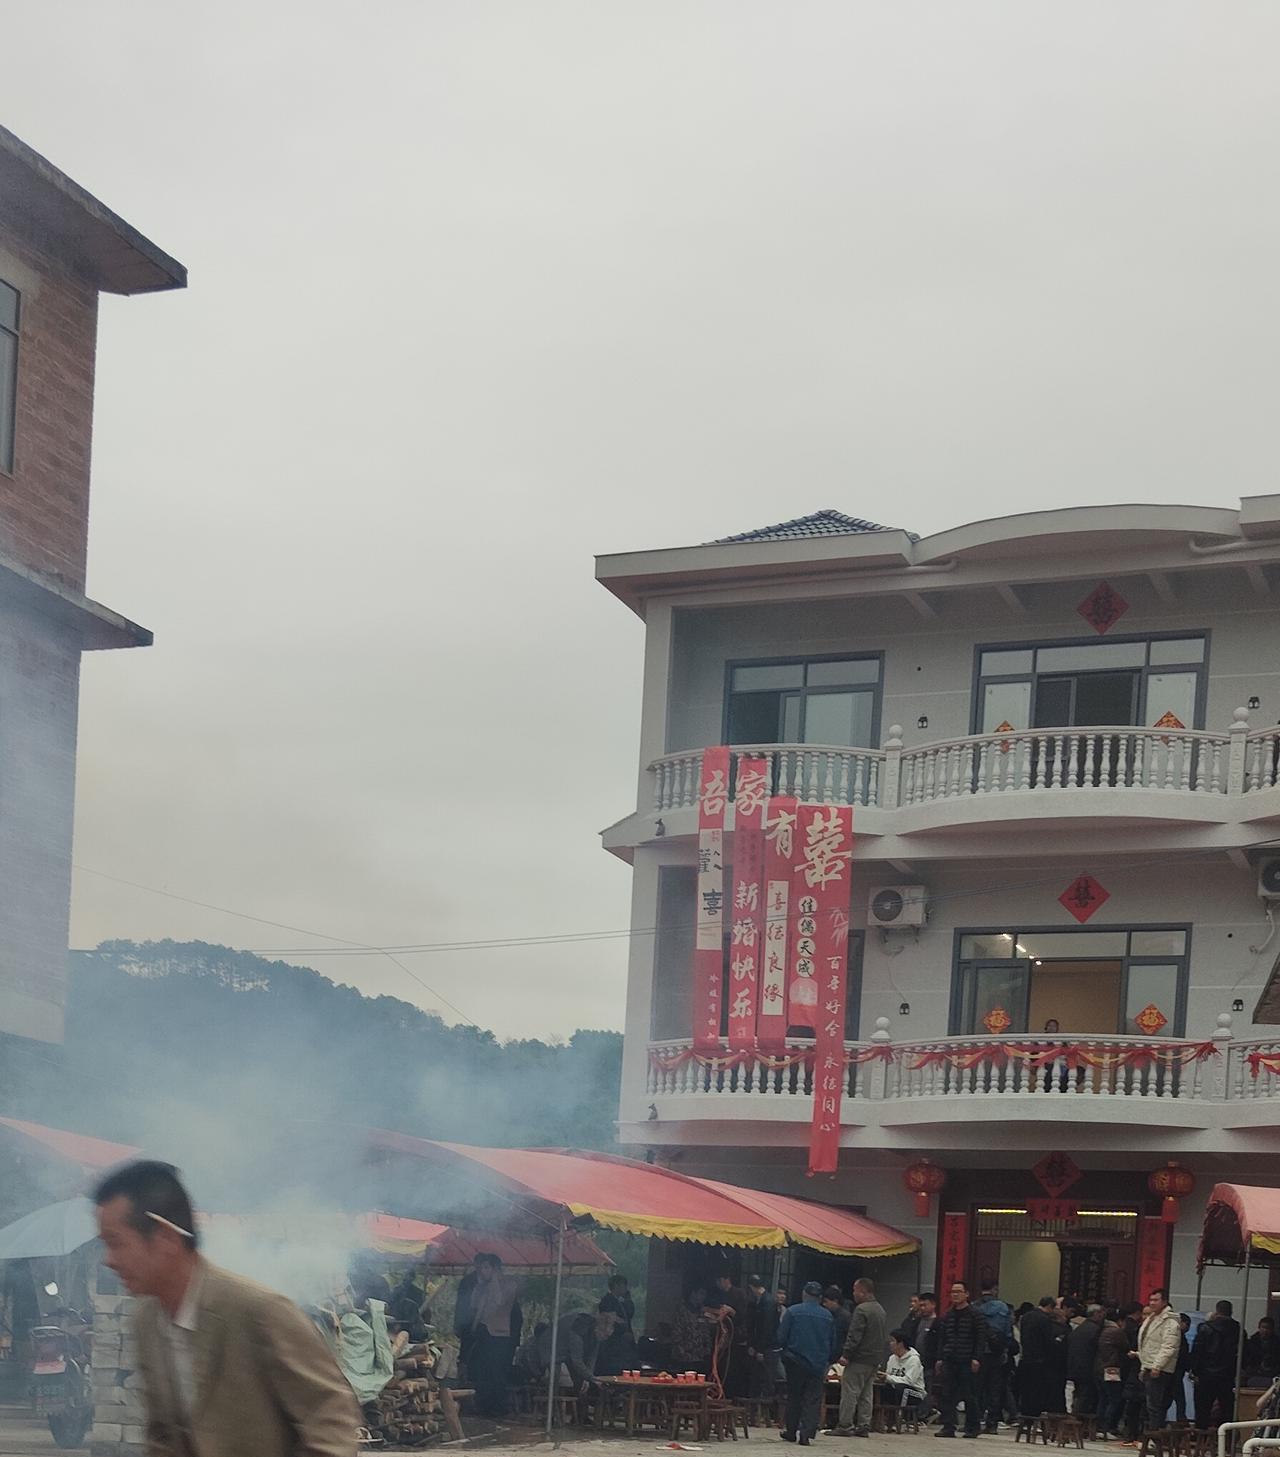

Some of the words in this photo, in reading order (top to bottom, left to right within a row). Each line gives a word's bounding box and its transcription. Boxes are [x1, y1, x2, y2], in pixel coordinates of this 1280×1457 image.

[728, 880, 759, 1019] 新婚快乐
[798, 897, 816, 977] 佳偶天成
